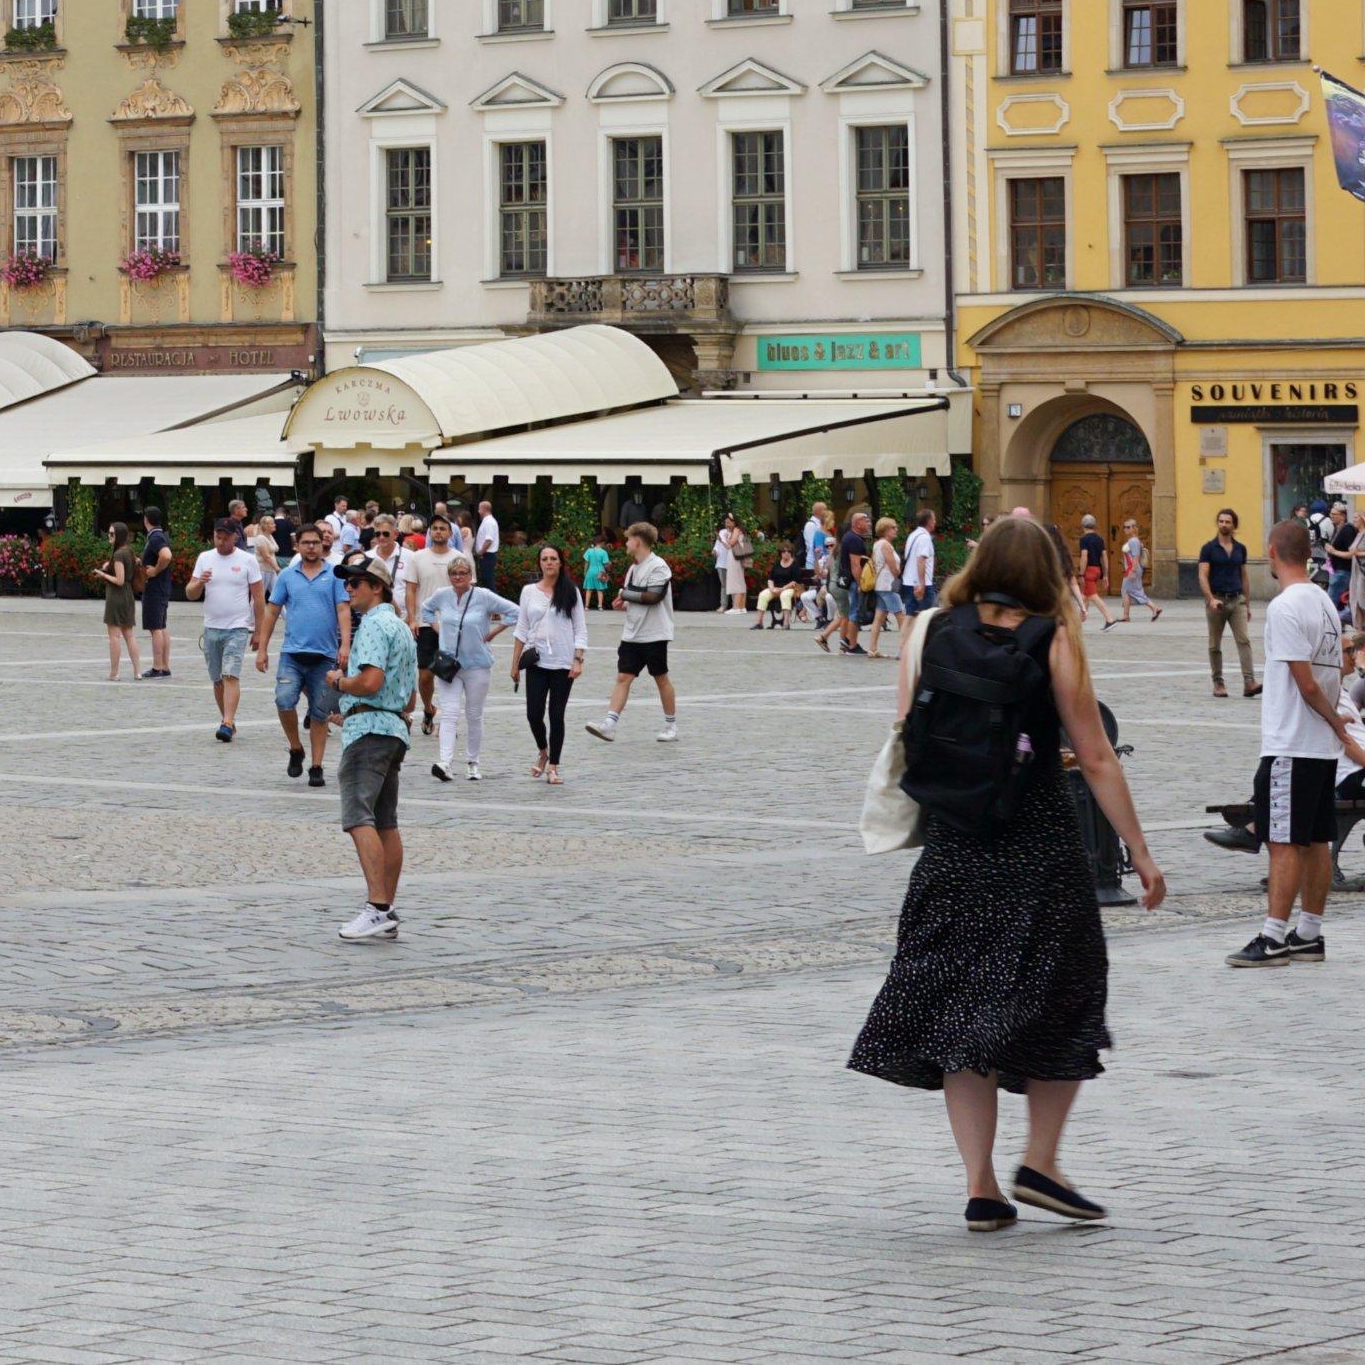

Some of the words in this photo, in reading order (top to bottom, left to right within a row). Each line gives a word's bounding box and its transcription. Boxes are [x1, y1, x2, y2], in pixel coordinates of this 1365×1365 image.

[110, 351, 196, 367] RESTAURACJA
[229, 350, 276, 366] HOTEL
[767, 343, 809, 361] blues
[814, 342, 826, 361] &
[831, 341, 865, 362] jazz
[869, 340, 880, 360] &
[885, 340, 910, 360] art
[334, 379, 390, 394] KARCZMA
[1191, 383, 1358, 401] SOUVENIRS
[324, 404, 406, 425] Lwowska
